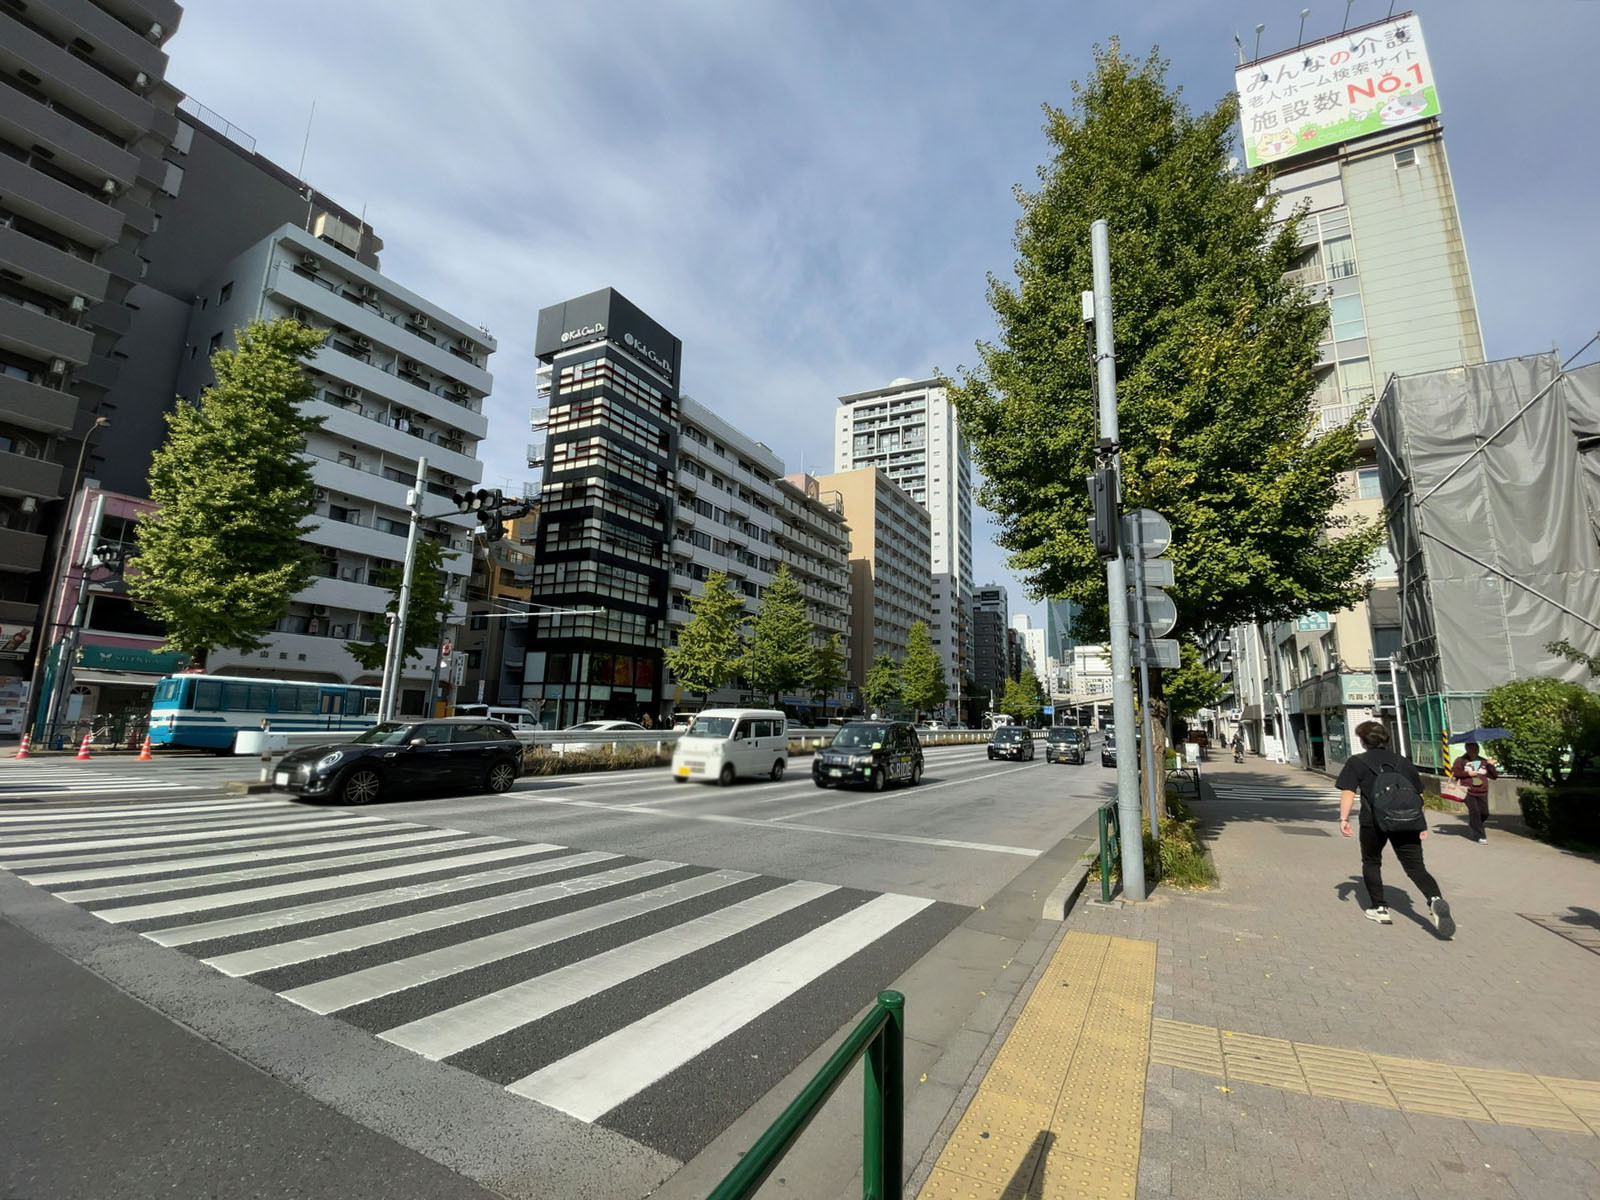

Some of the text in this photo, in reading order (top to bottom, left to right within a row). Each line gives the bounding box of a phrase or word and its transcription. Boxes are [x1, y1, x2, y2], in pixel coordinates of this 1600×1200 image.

[1246, 25, 1415, 93] みんなの介護
[1248, 49, 1417, 109] 老人ホーム検索サイト
[1251, 89, 1342, 133] 施設数
